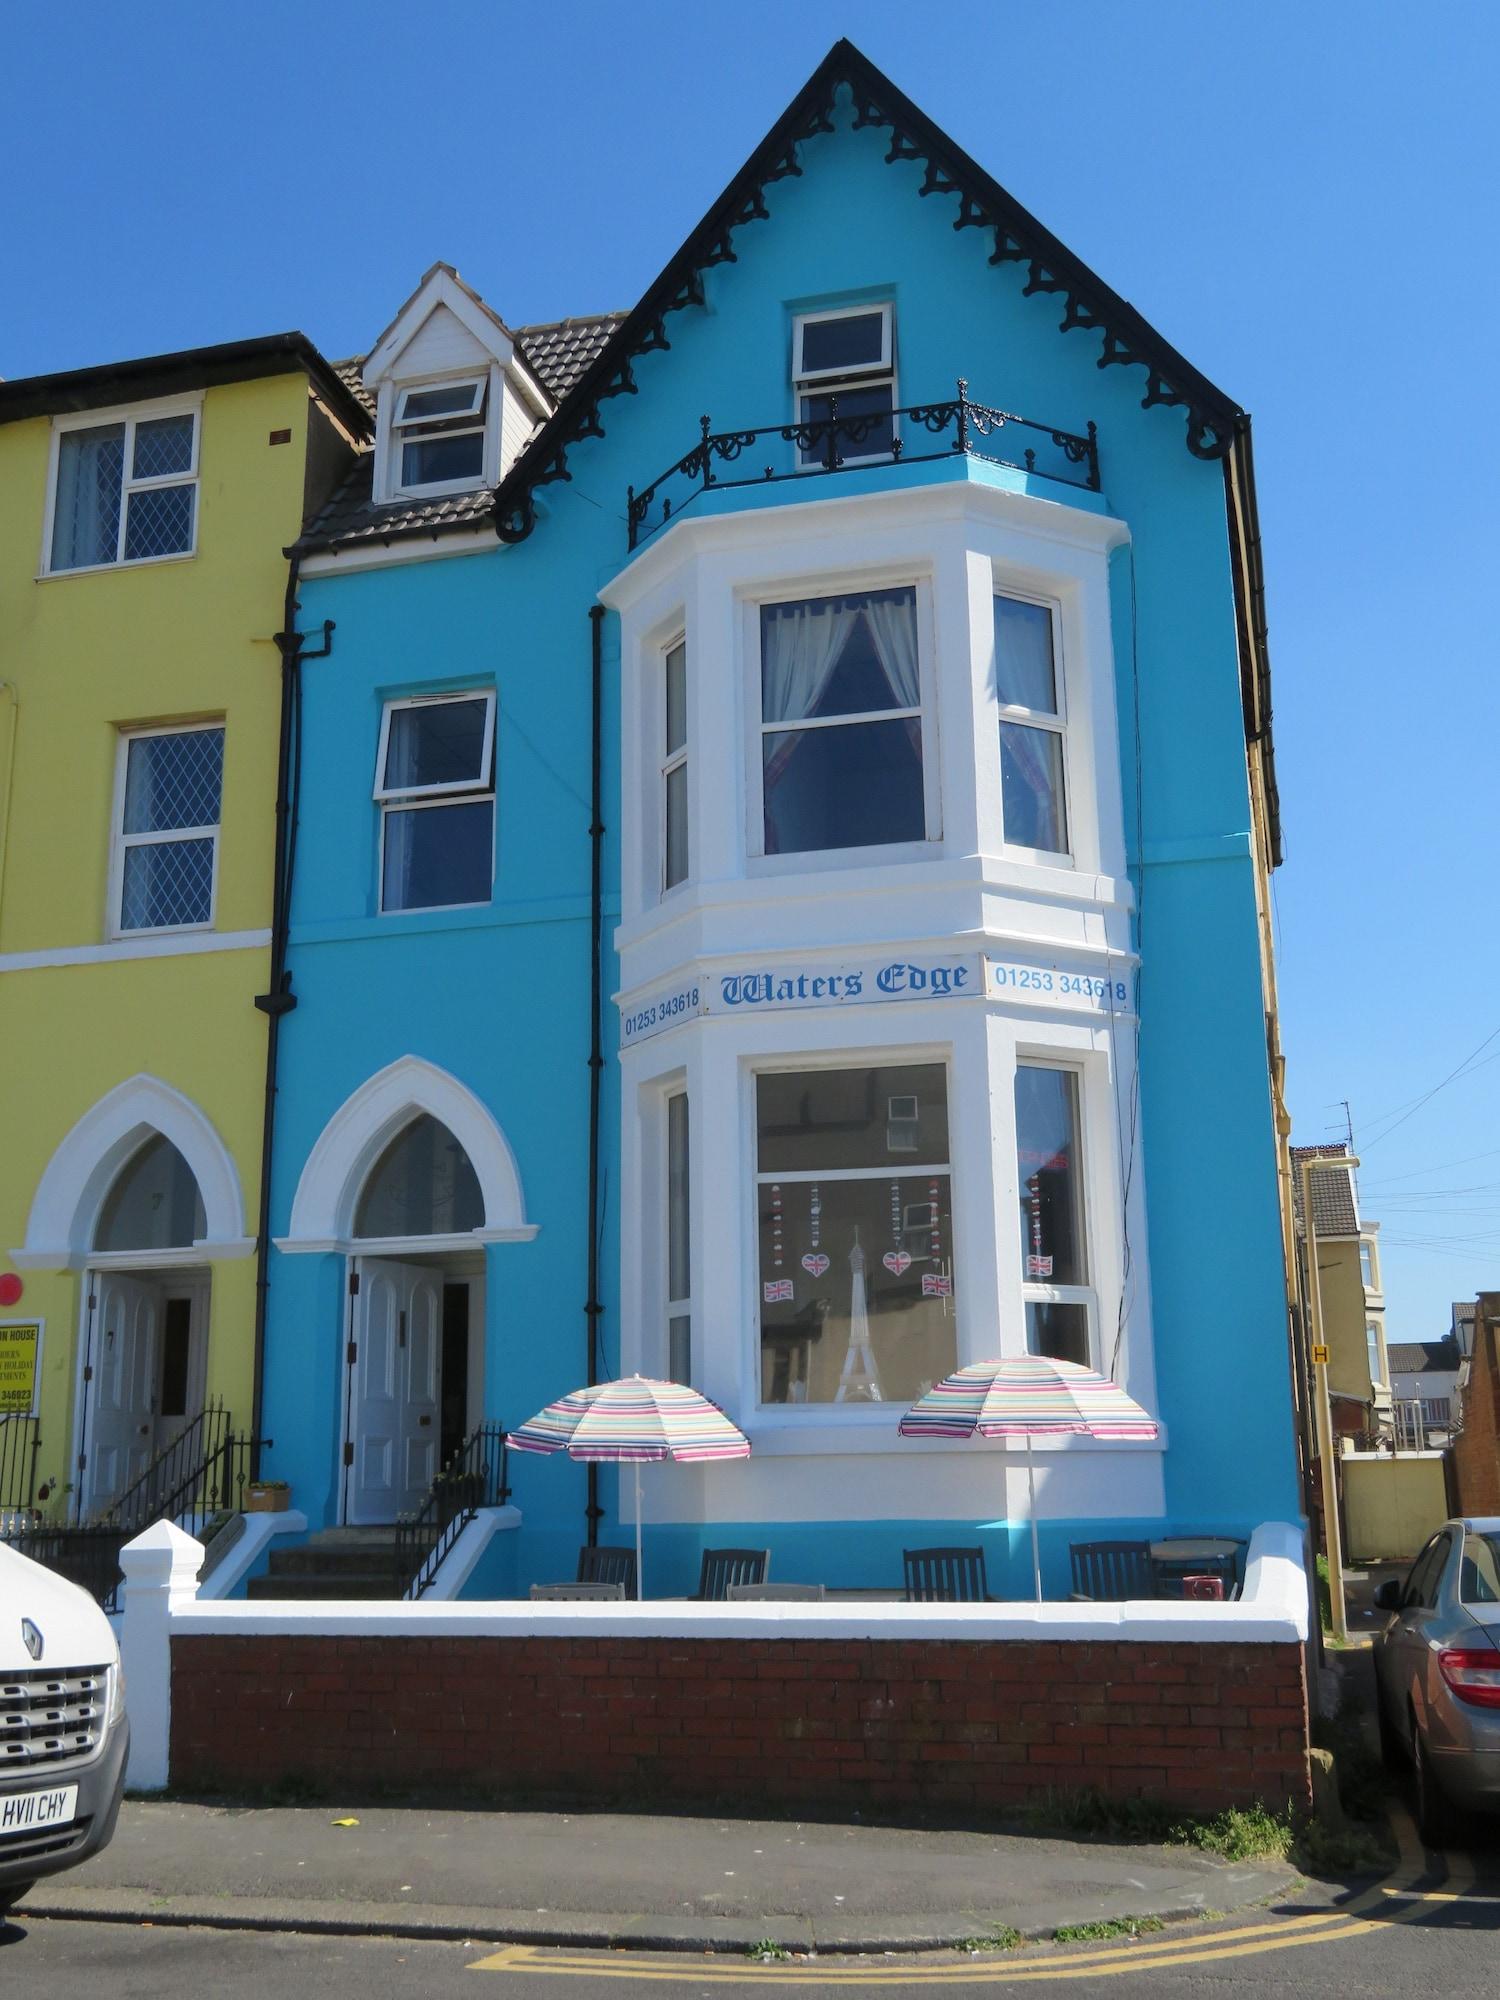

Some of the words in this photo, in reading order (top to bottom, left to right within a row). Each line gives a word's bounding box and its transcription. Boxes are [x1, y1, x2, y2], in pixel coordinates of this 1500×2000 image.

[876, 963, 968, 995] Edge
[994, 967, 1053, 991] 01253
[1059, 975, 1127, 1000] 343618
[625, 1007, 656, 1036] 01253
[659, 988, 699, 1021] 343618
[10, 1329, 35, 1341] HOUSE
[1314, 1346, 1328, 1362] H
[37, 1792, 67, 1821] CHY
